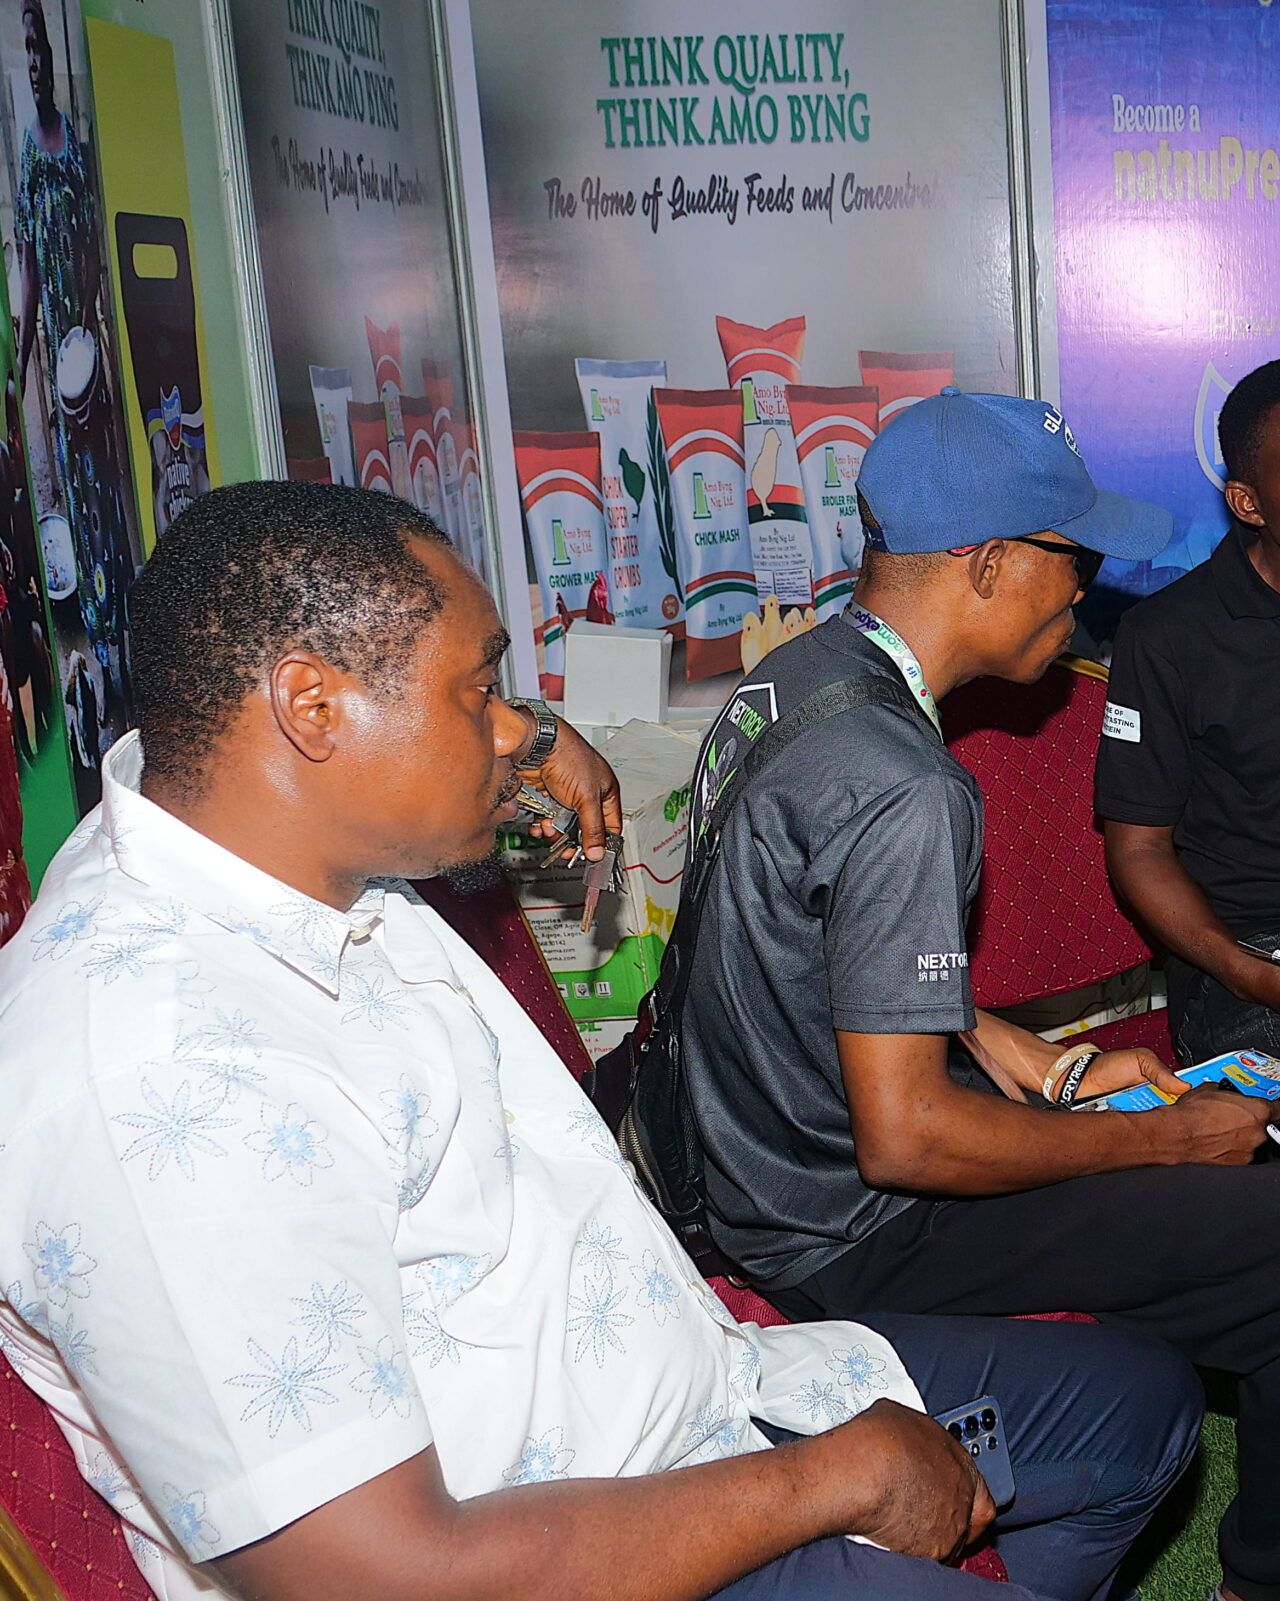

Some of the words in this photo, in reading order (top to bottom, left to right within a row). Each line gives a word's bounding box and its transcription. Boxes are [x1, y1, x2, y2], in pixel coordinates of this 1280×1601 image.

[601, 36, 710, 87] THINK
[713, 33, 850, 95] QUALITY,
[286, 43, 337, 116] THINK
[334, 60, 364, 123] AMO
[364, 70, 399, 132] BYNG
[596, 97, 706, 148] THINK
[708, 96, 778, 146] AMO
[789, 93, 871, 143] BYNG
[1112, 94, 1185, 133] Become
[1188, 105, 1201, 132] a
[543, 177, 576, 220] The
[582, 176, 635, 221] Home
[641, 176, 663, 234] of
[669, 174, 740, 226] Quality
[744, 172, 794, 216] Feeds
[801, 172, 836, 225] and
[753, 386, 772, 399] Amo
[822, 496, 845, 506] BROILER
[839, 505, 857, 516] MASH
[694, 531, 717, 546] CHICK
[719, 528, 741, 543] MASH
[549, 572, 583, 588] GROWER
[727, 697, 769, 741] NEXTORCH
